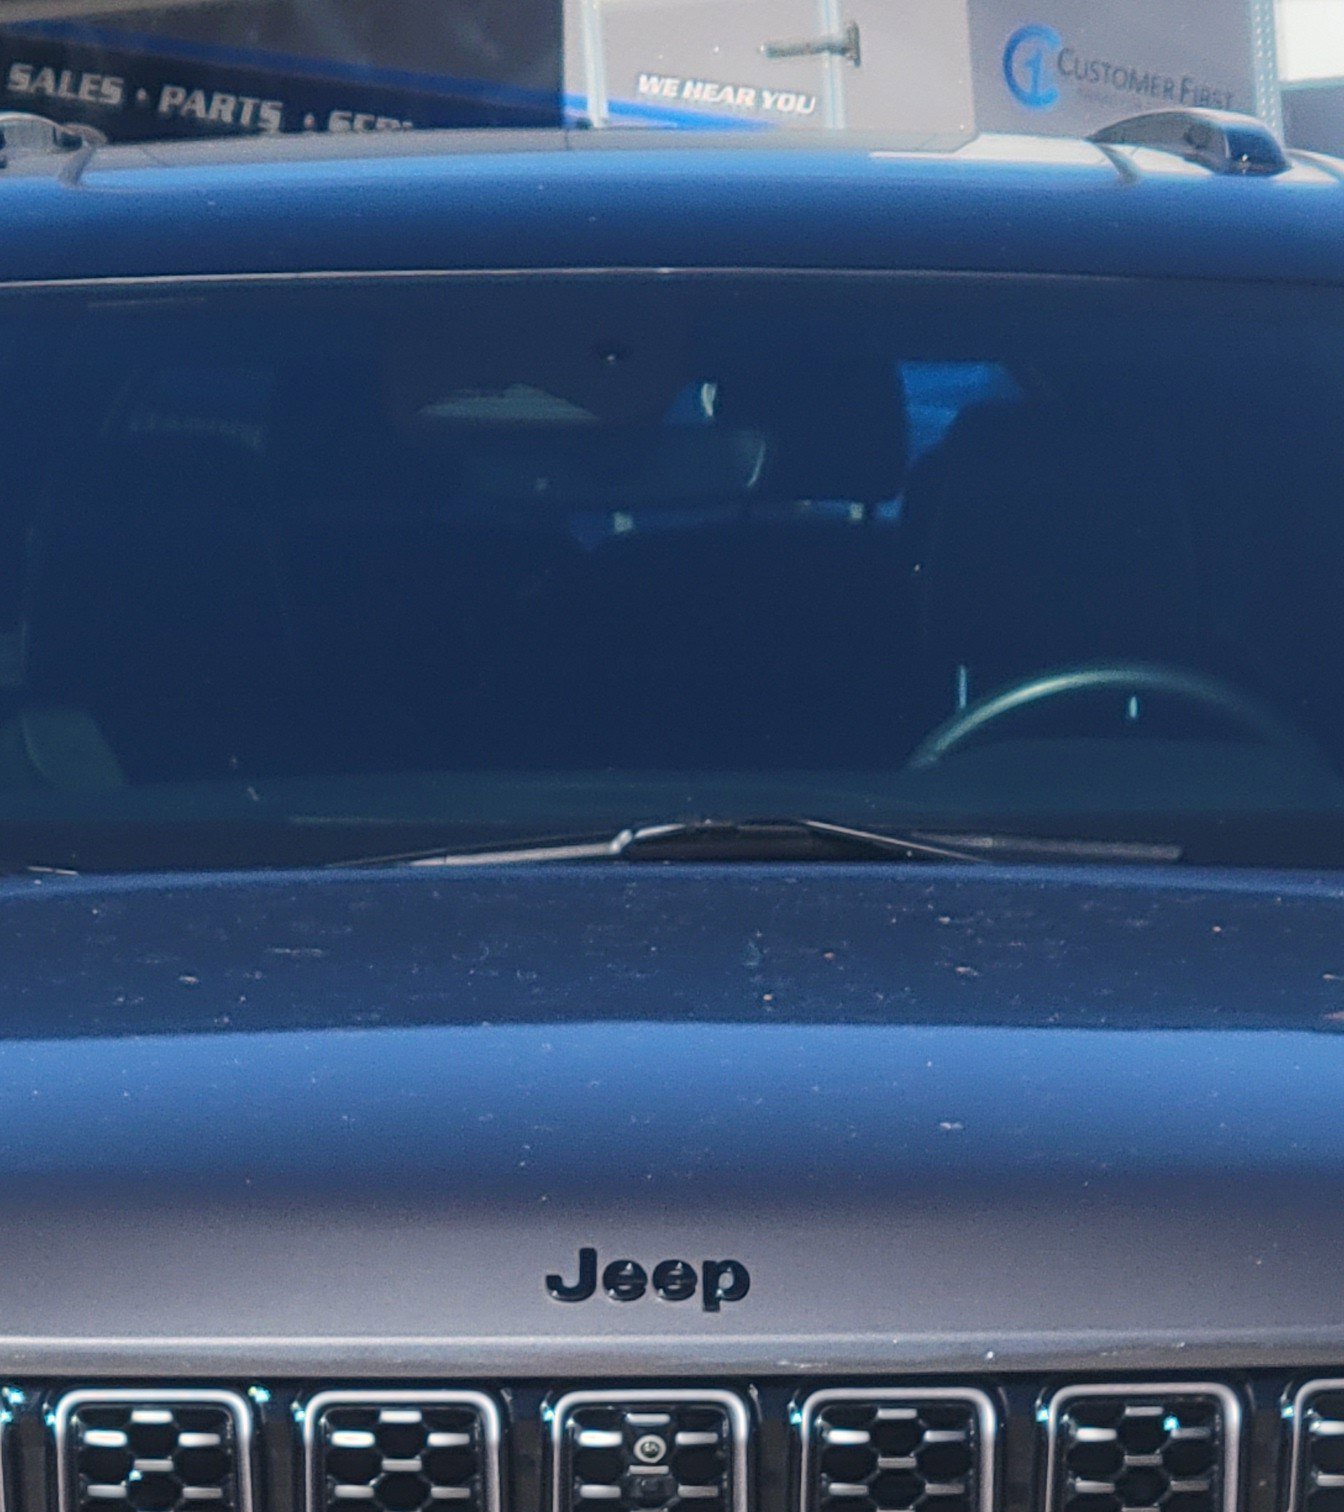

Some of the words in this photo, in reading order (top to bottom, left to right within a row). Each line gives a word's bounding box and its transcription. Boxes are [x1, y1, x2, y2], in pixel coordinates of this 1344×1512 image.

[8, 62, 124, 105] SALES
[158, 84, 283, 134] PARTS
[638, 73, 680, 98] WE
[682, 79, 756, 107] HEAR
[761, 89, 816, 115] YOU
[545, 1247, 751, 1313] Jeep
